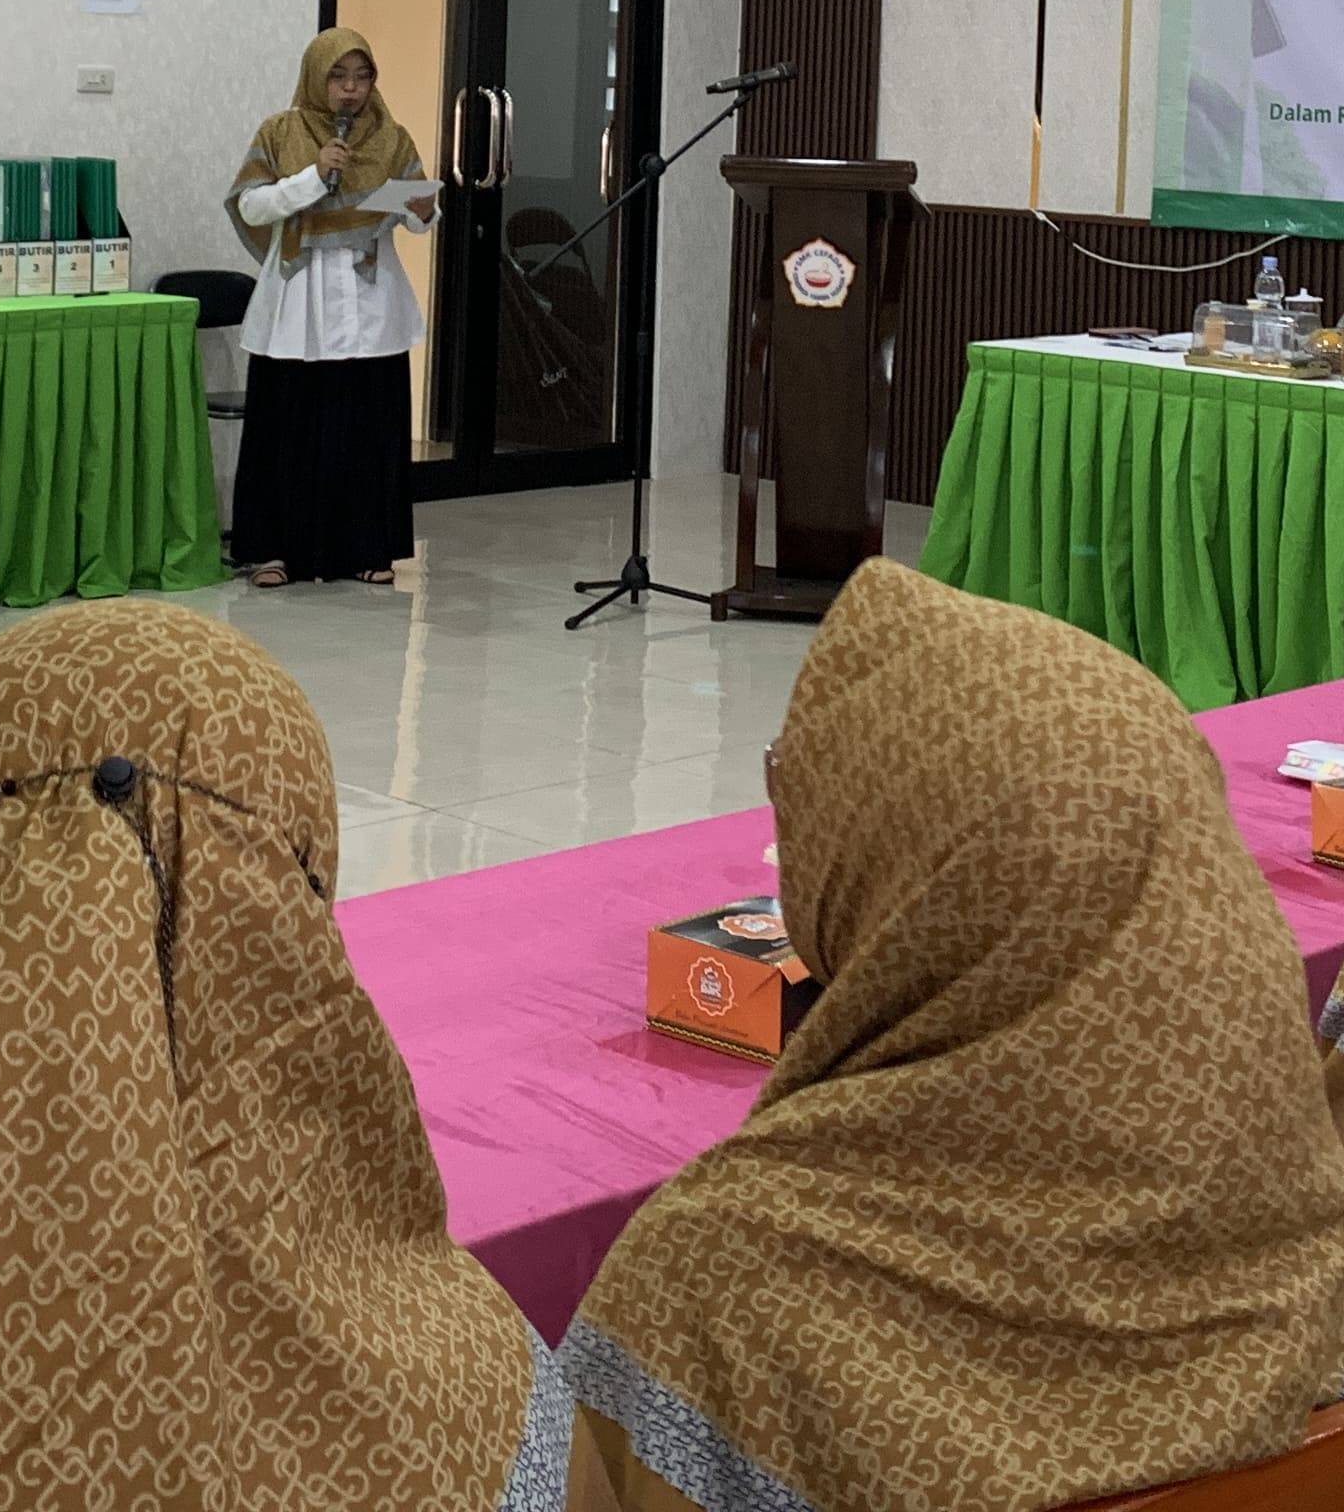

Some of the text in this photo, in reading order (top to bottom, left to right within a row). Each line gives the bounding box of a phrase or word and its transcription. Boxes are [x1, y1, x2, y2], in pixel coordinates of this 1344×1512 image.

[1269, 103, 1332, 124] Dalam
[19, 246, 52, 257] BUTIR
[58, 245, 90, 255] BUTIR
[96, 242, 128, 253] BUTIR
